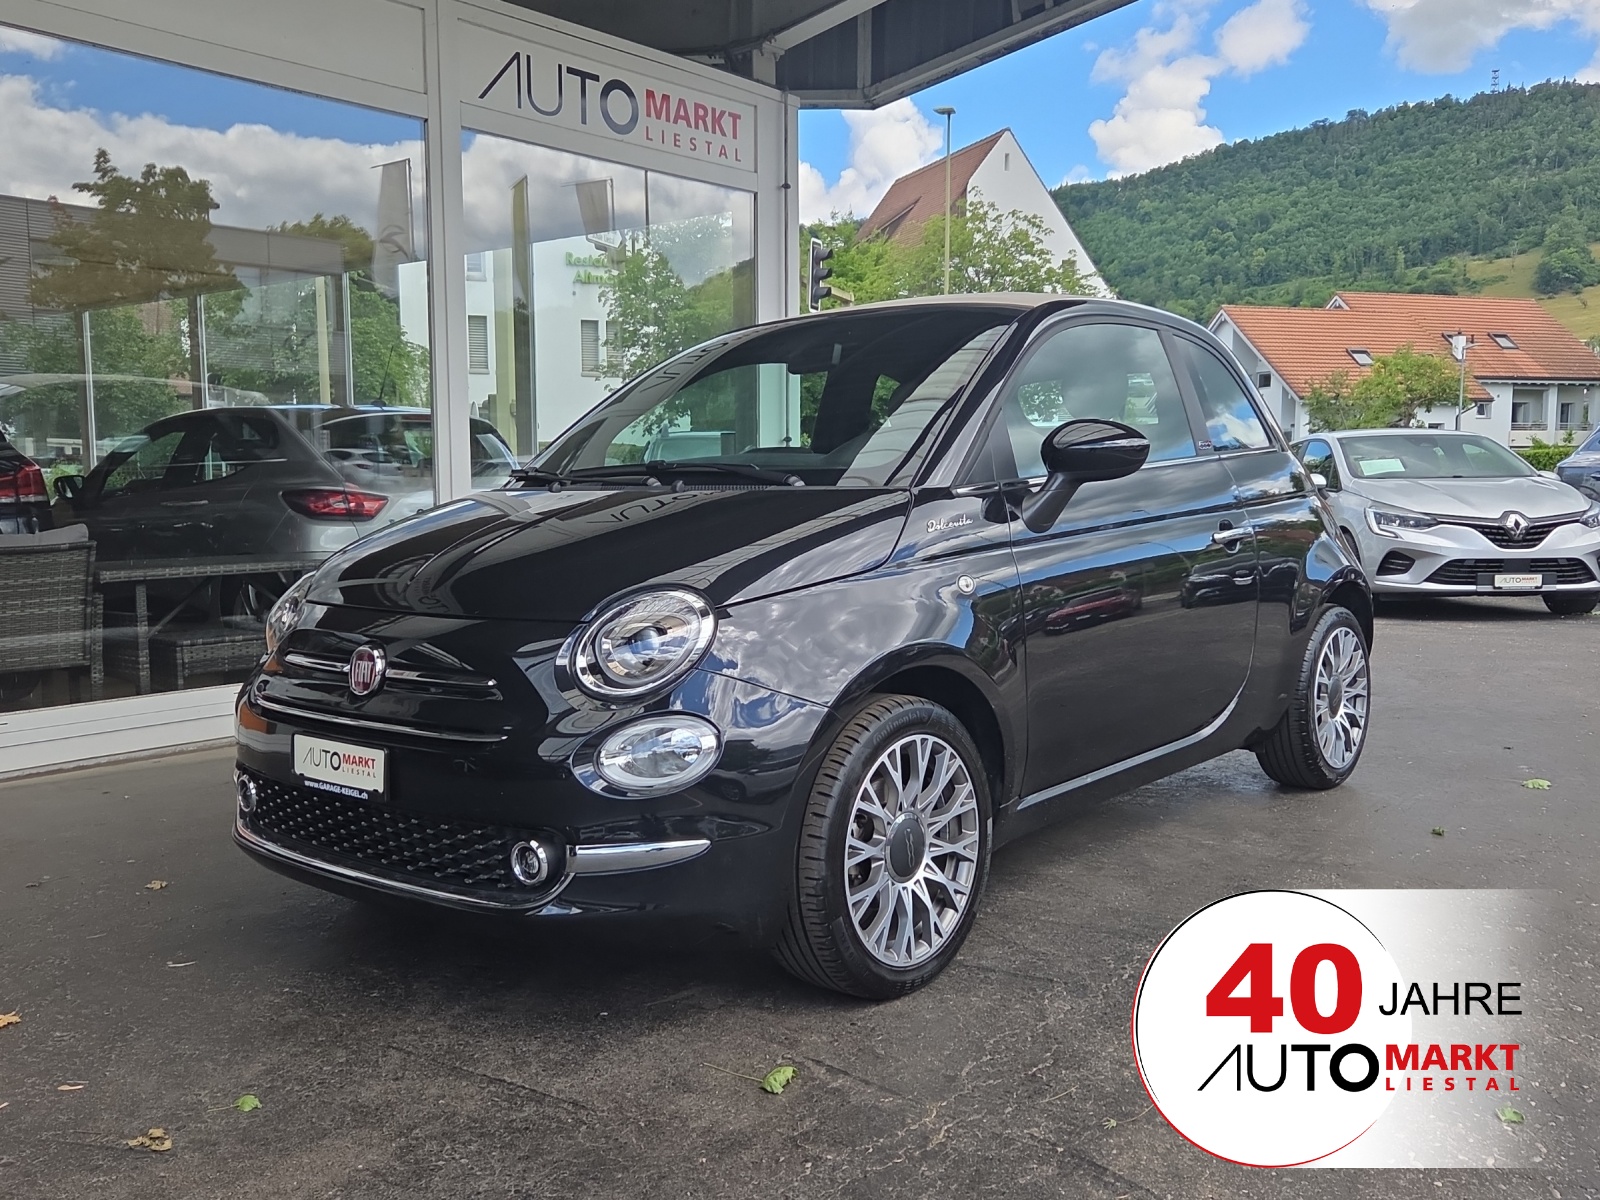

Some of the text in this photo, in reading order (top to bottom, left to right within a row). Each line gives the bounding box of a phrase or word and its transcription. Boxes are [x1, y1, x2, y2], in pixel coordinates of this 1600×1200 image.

[478, 51, 742, 140] AUTO MARKT
[645, 125, 742, 163] LIESTAL
[354, 660, 374, 684] FIAT
[302, 746, 376, 772] AUTO MARKT
[342, 766, 377, 779] LIESTAL
[304, 780, 369, 800] www.GARAGE-KEIGEL.ch
